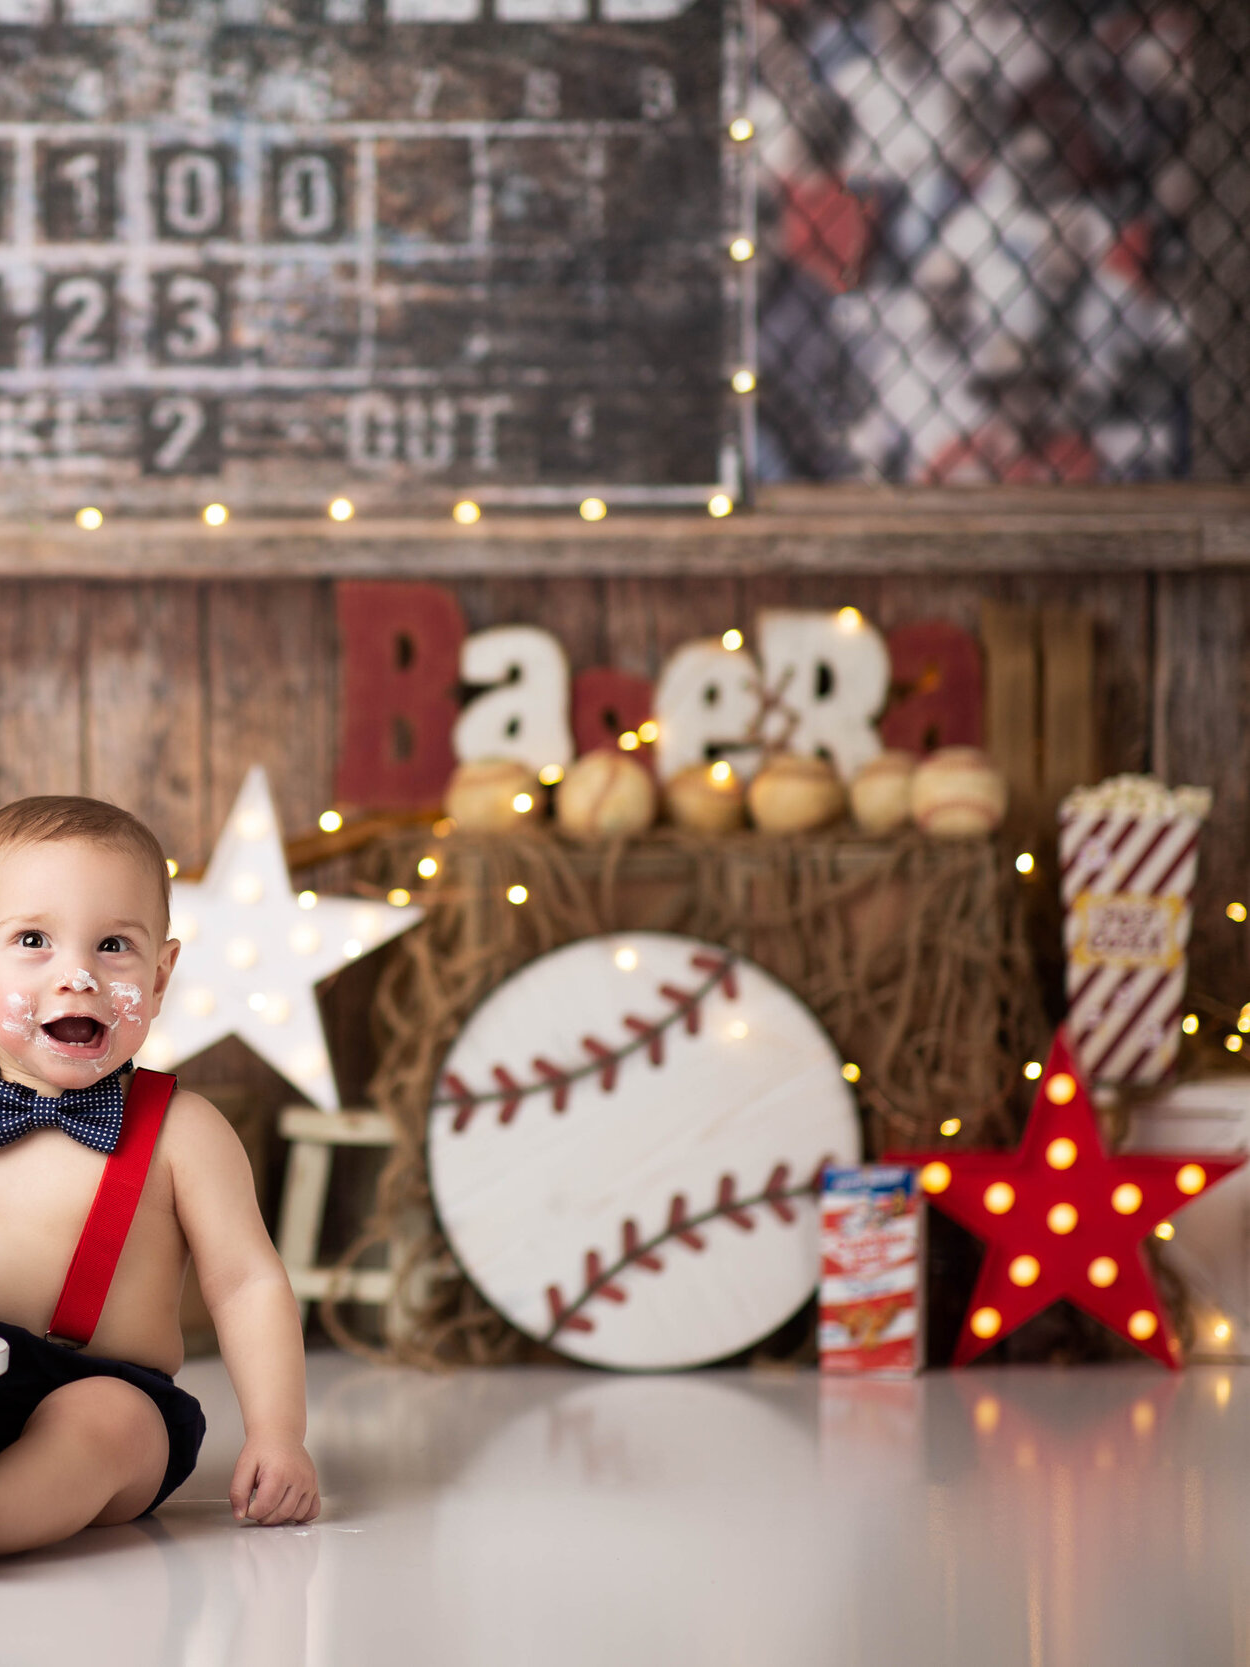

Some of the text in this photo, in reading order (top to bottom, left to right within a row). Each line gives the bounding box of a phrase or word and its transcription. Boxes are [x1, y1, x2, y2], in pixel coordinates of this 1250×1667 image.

[63, 153, 100, 232] 1
[164, 153, 222, 234] 0
[279, 154, 335, 235] 0
[53, 277, 107, 359] 2
[165, 276, 221, 358] 3
